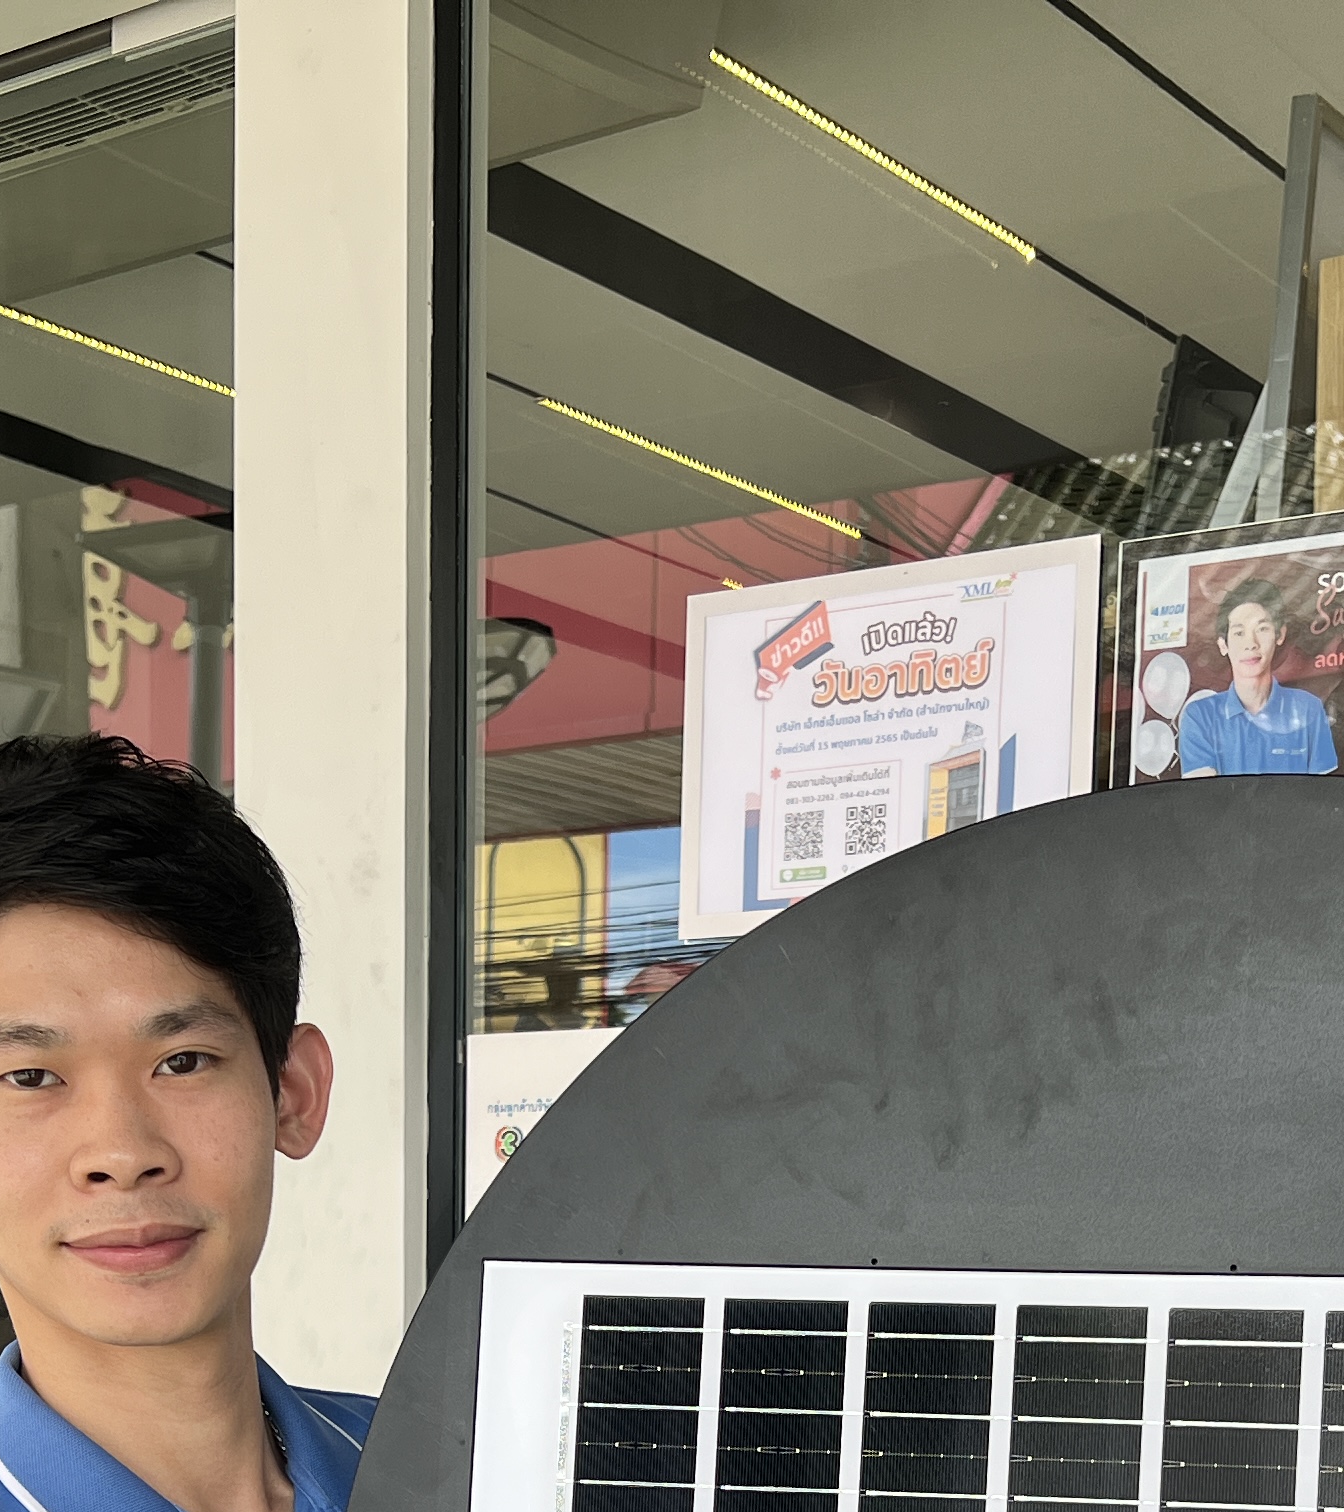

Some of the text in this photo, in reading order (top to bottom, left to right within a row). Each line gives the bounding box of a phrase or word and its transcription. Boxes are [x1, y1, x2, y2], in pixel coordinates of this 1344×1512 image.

[957, 582, 996, 599] XML
[861, 612, 957, 655] เปิดแล้ว!
[812, 637, 995, 707] วันอาทิตย์
[875, 734, 898, 744] 2565
